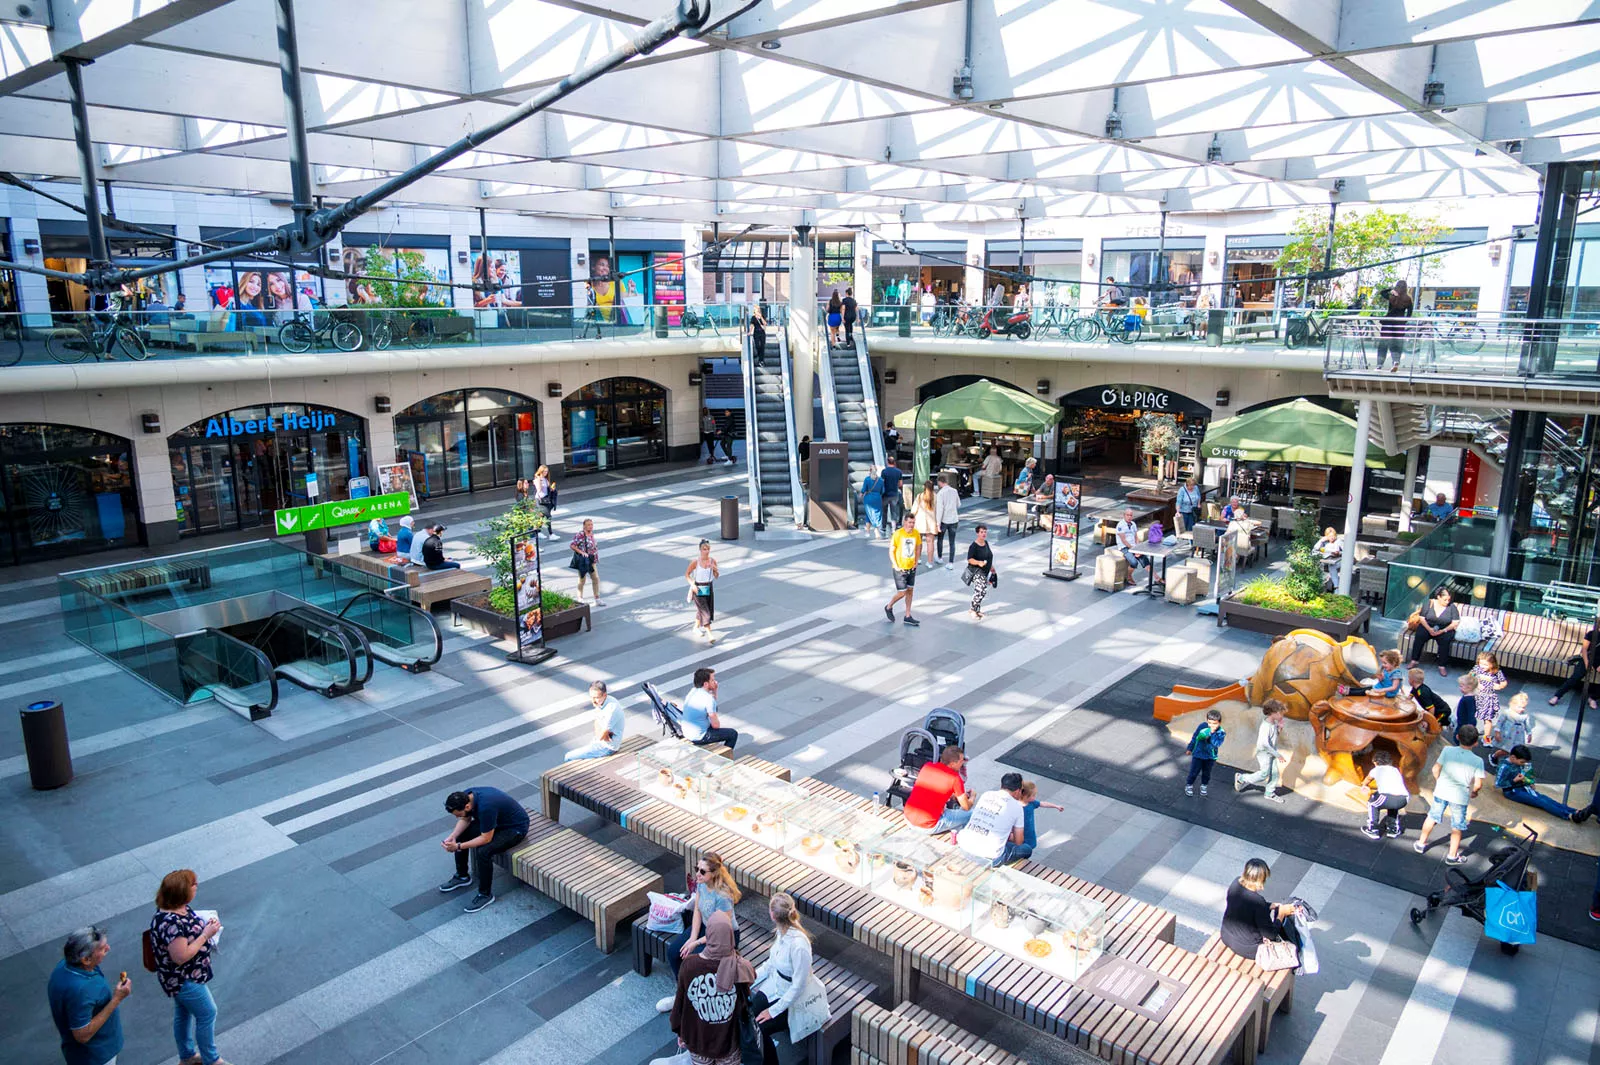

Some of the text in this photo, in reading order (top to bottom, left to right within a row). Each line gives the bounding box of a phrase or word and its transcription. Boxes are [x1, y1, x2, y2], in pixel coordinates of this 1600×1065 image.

[1134, 391, 1169, 409] PLACE
[205, 410, 336, 438] Albert Heijn
[370, 500, 403, 511] ARENA
